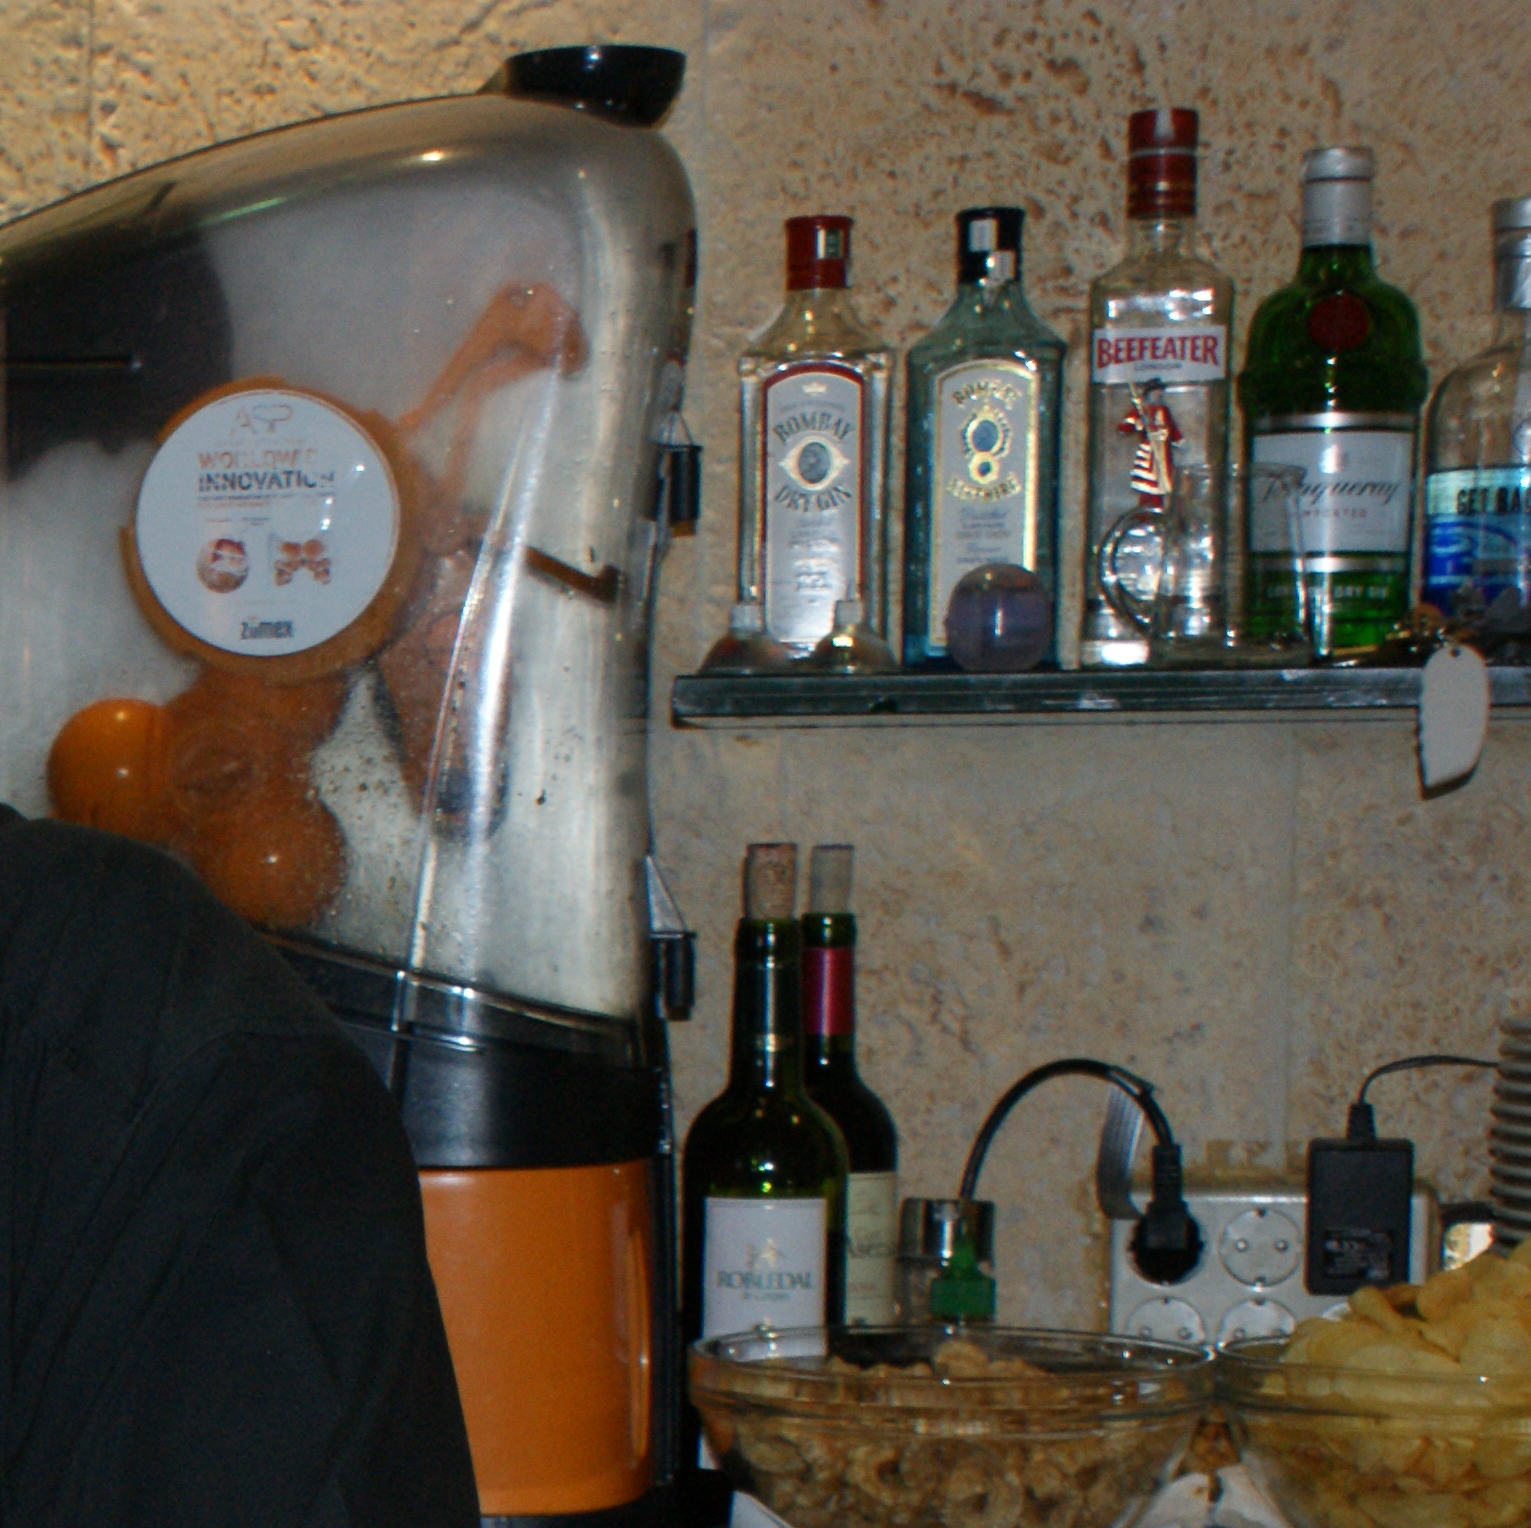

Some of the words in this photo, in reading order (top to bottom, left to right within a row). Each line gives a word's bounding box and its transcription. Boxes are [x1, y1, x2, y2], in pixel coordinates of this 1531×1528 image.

[1096, 334, 1220, 369] BEEFEATER
[771, 411, 855, 443] BOMBAY
[772, 484, 812, 513] DRY
[815, 483, 855, 512] GIN
[1457, 487, 1489, 516] GET
